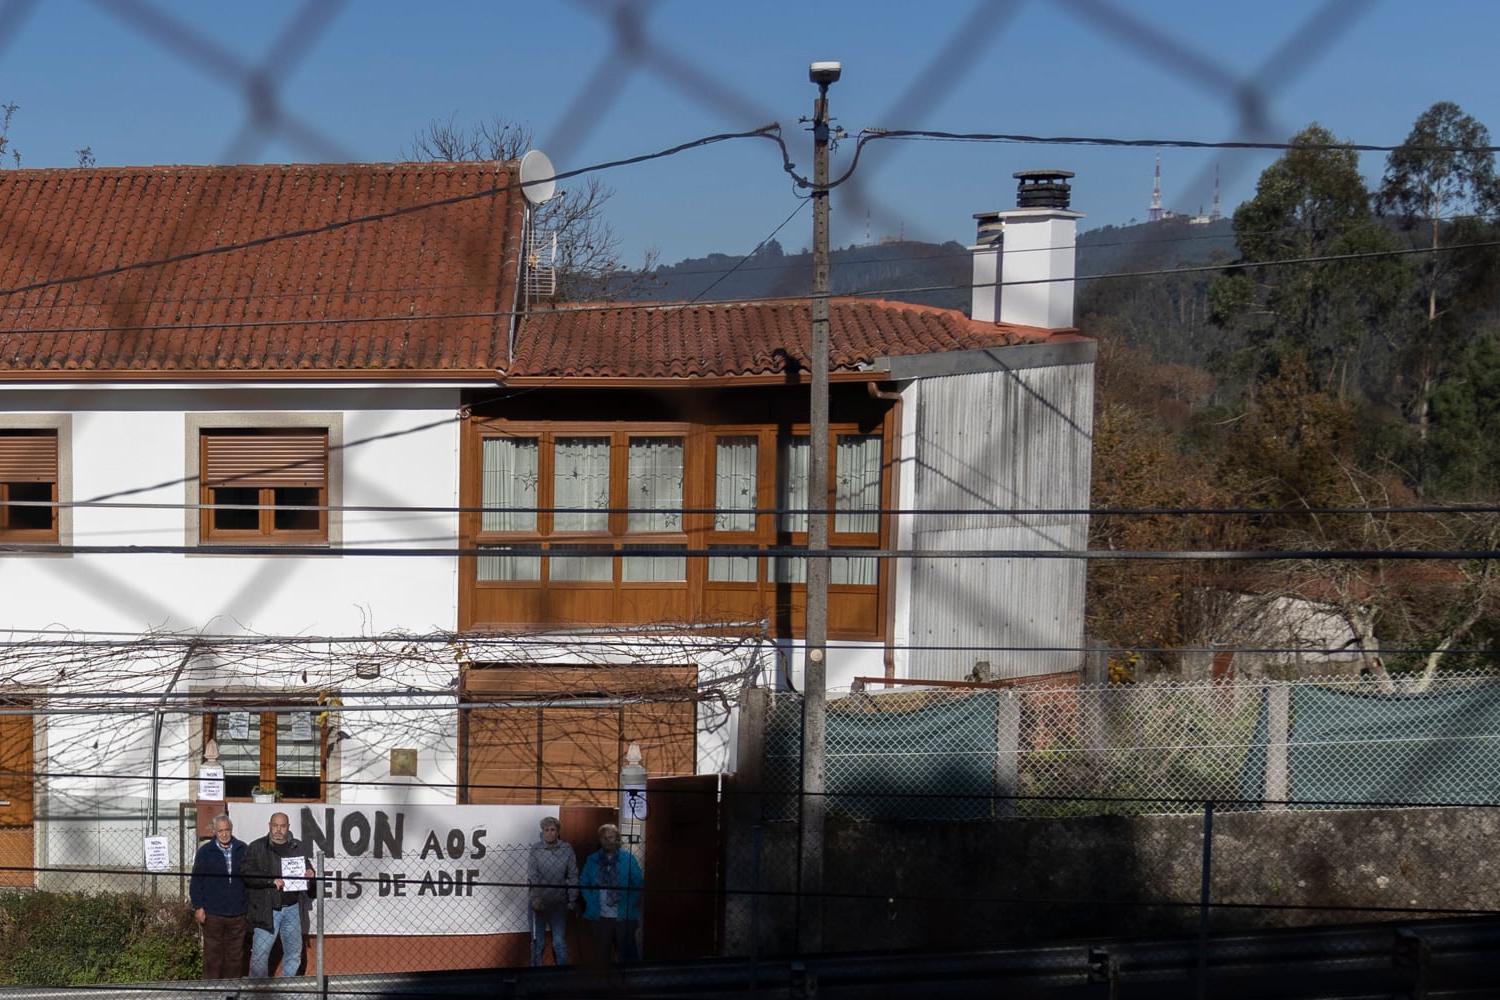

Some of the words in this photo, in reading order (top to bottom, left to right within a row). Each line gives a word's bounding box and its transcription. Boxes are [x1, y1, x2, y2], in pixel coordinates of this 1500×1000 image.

[301, 806, 405, 860] NON
[420, 829, 487, 860] AOS
[322, 870, 362, 899] EIS
[379, 873, 406, 897] DE
[418, 869, 480, 898] ADIF
